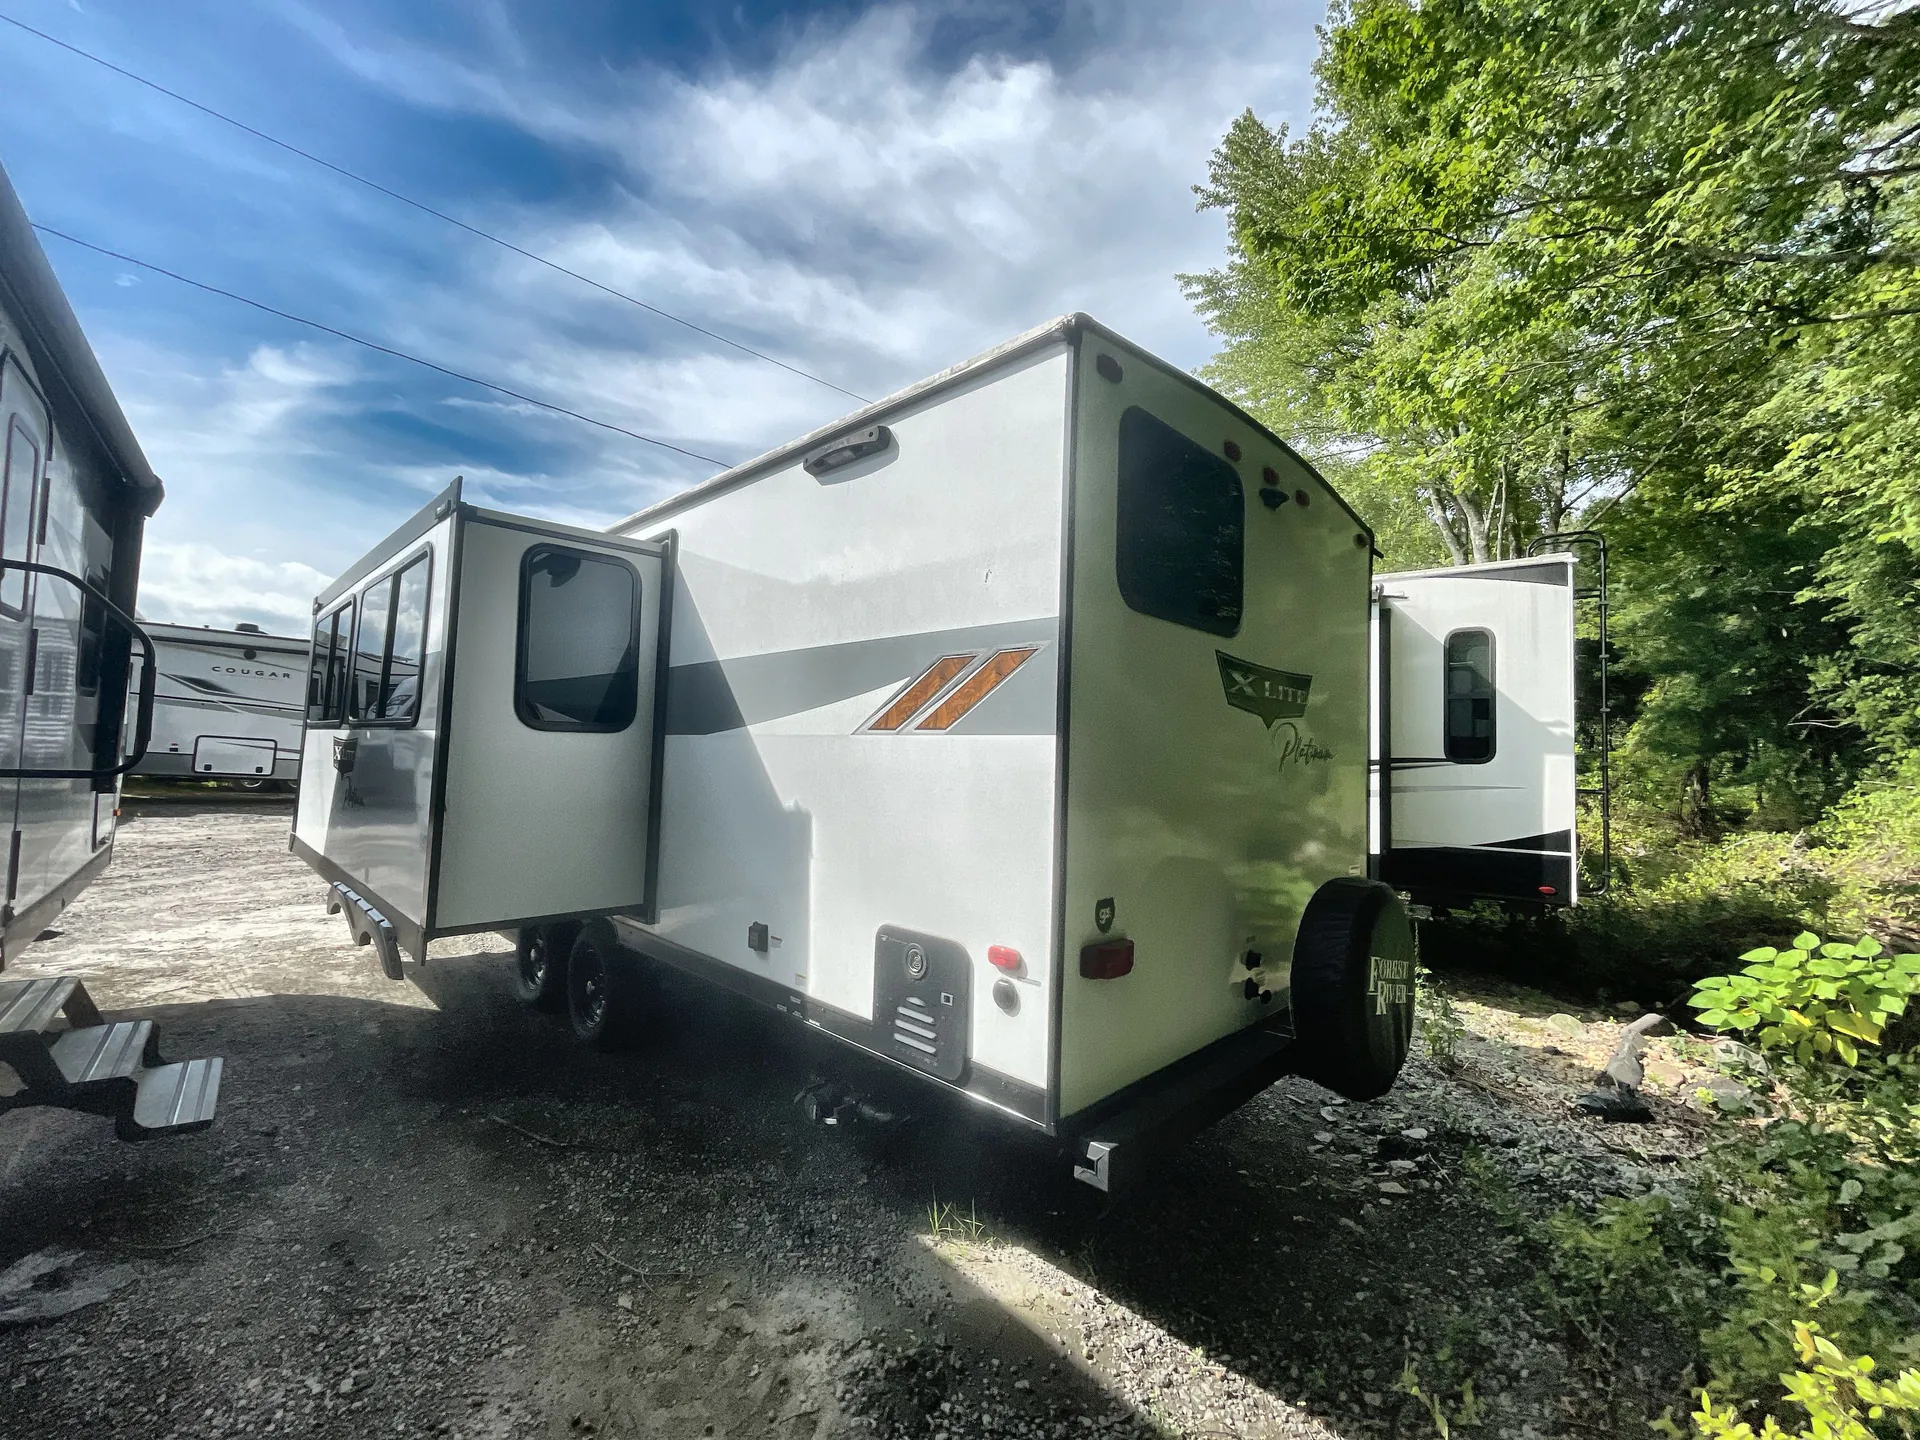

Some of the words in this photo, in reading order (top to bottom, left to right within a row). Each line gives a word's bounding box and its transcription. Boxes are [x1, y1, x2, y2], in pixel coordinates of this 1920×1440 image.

[211, 665, 291, 679] COUGAR
[1227, 668, 1260, 697] X
[1264, 681, 1308, 704] LITE
[333, 745, 343, 761] X
[1369, 956, 1410, 991] FOREST
[1376, 981, 1407, 1015] RIVER
